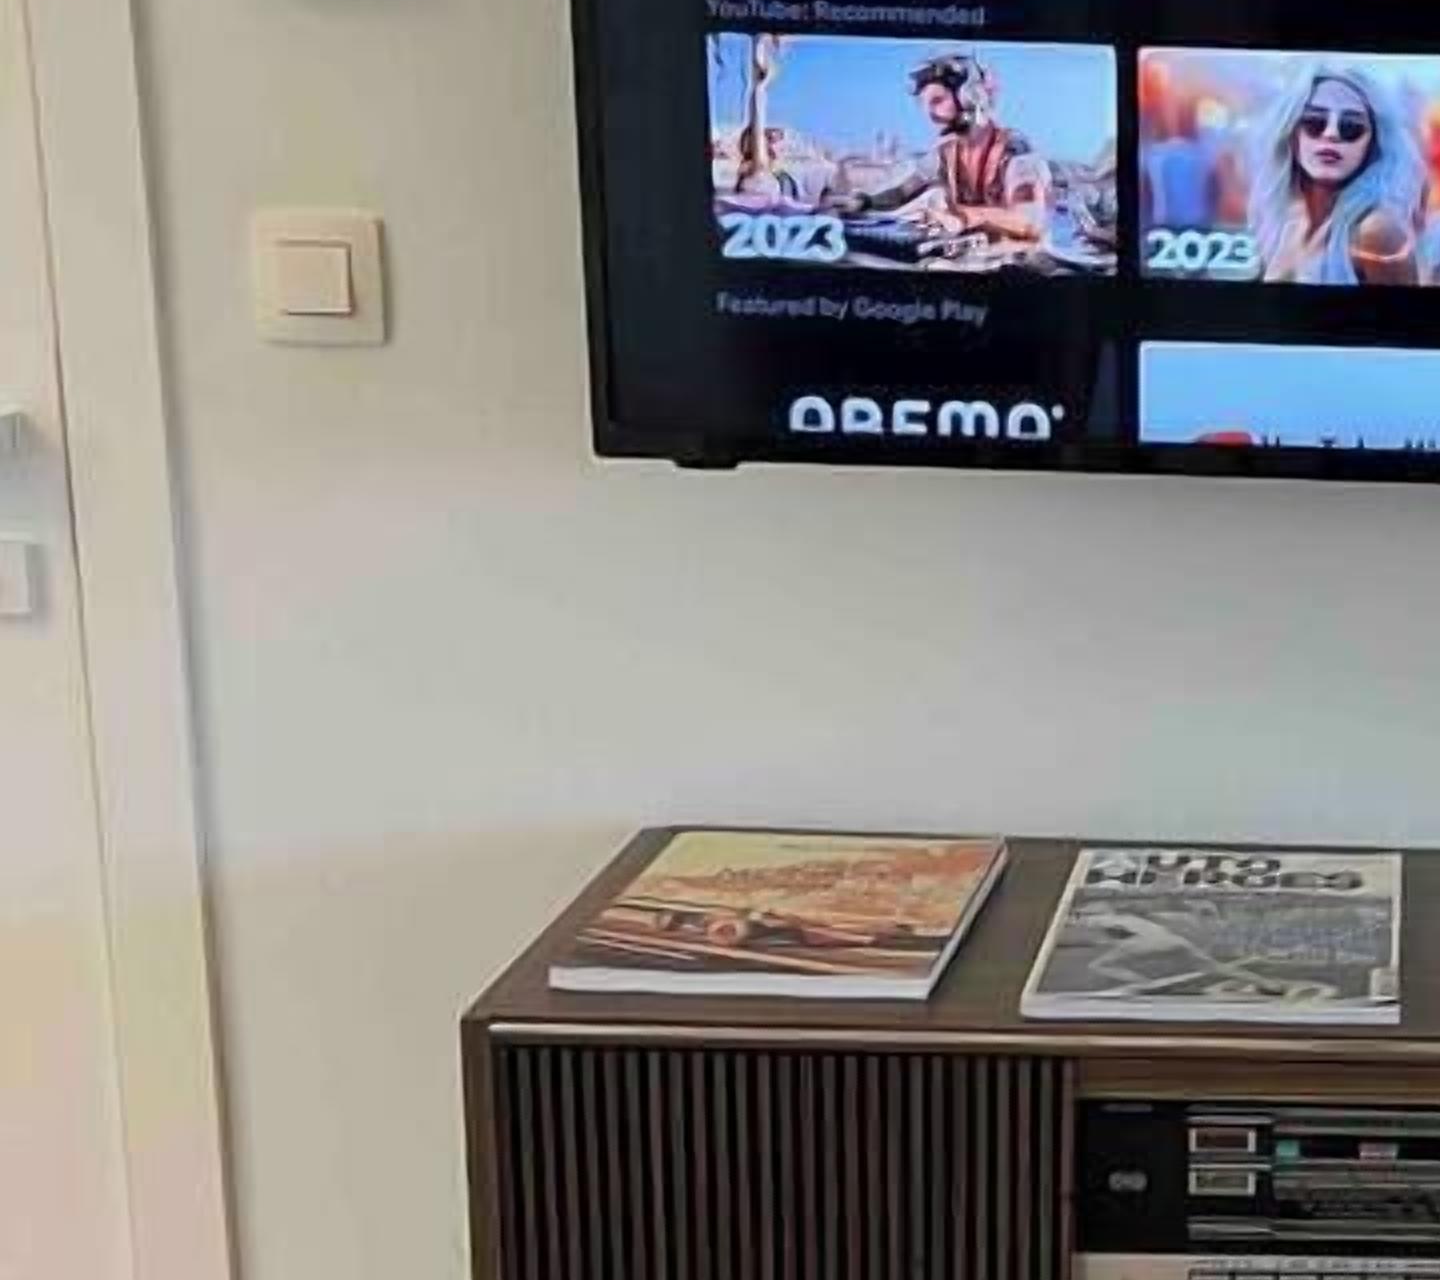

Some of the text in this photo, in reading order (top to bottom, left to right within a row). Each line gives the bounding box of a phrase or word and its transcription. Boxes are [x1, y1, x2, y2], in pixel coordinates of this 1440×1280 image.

[813, 0, 985, 26] Recommended
[719, 212, 845, 262] 2023
[1147, 229, 1258, 270] 2023
[716, 292, 816, 318] Featured
[819, 295, 848, 321] by
[853, 296, 936, 325] Google
